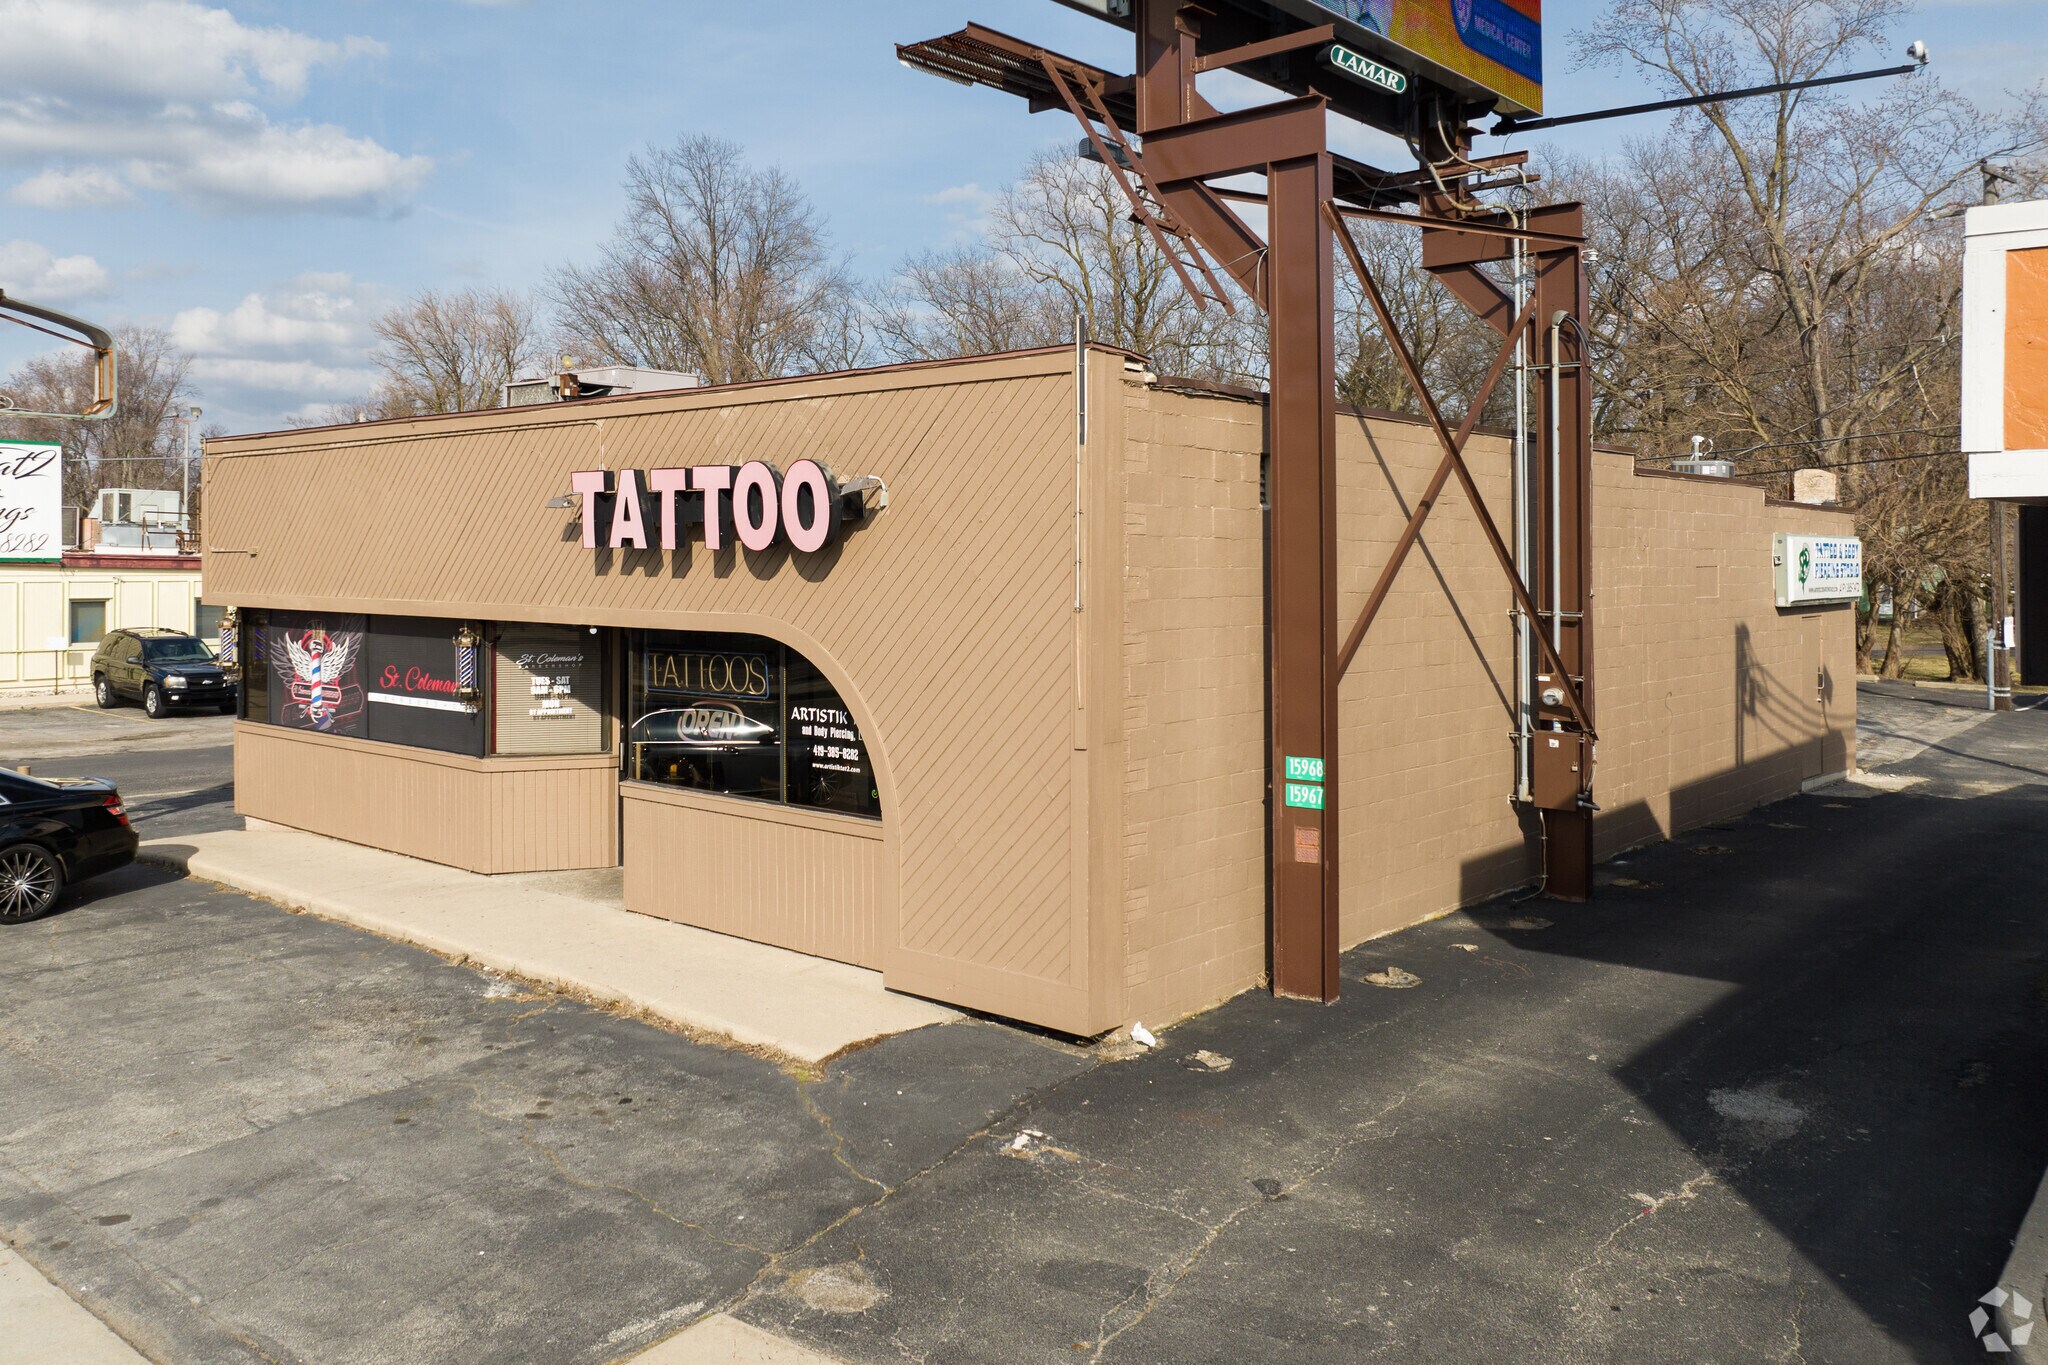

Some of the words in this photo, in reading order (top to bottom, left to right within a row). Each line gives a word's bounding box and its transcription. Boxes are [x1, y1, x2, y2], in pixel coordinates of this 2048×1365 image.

[1474, 15, 1505, 46] MEDICAL
[1506, 33, 1532, 58] CENTER
[1336, 49, 1399, 90] LAMAR
[570, 458, 832, 553] TATTOO
[536, 653, 585, 665] Coleman's
[379, 665, 403, 689] St.
[530, 676, 551, 686] TUES
[555, 675, 571, 685] SAT
[648, 653, 767, 695] TATTOOS
[681, 709, 736, 740] OPEN
[790, 706, 848, 725] ARTISTIK
[801, 725, 812, 736] and
[813, 725, 828, 739] Body
[1289, 758, 1324, 778] 15968
[1289, 785, 1324, 805] 15967
